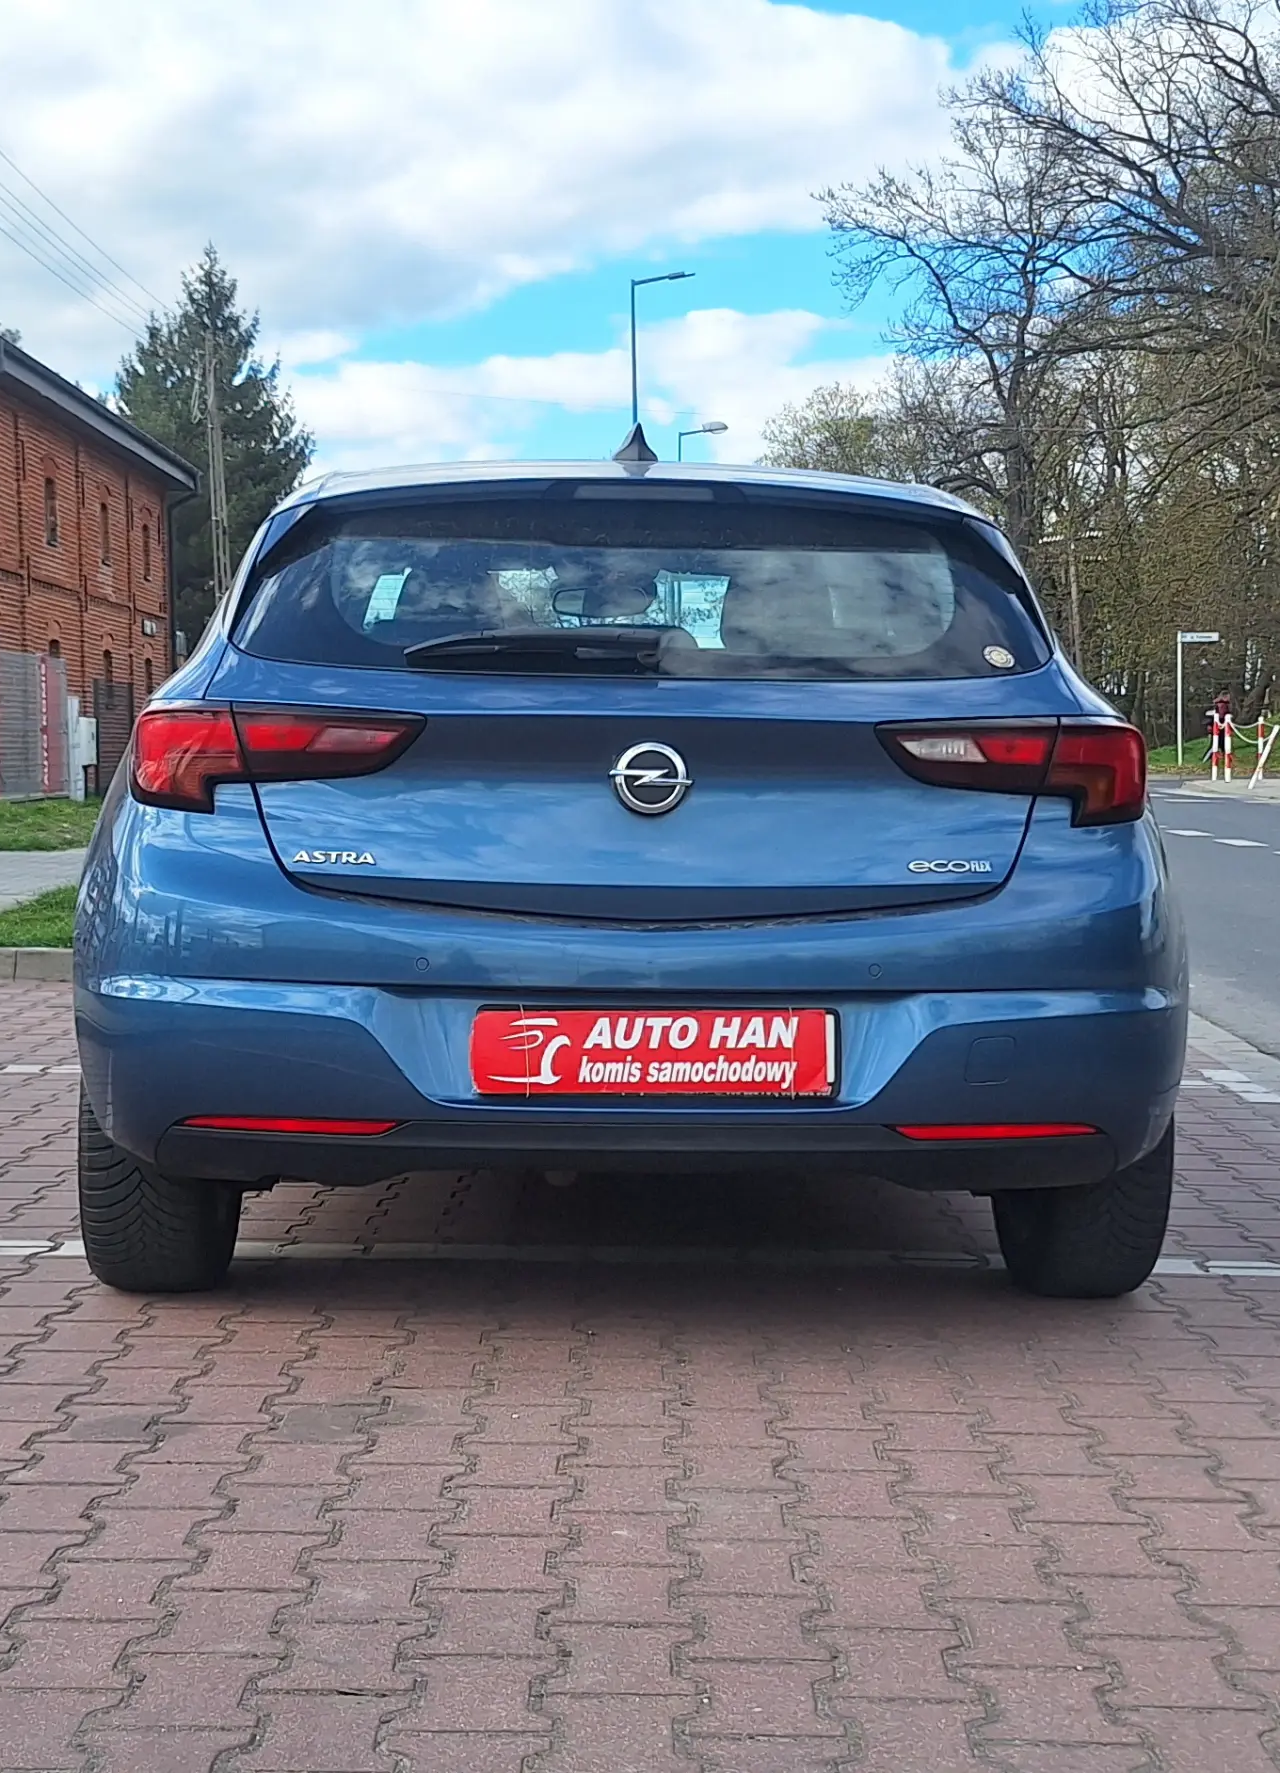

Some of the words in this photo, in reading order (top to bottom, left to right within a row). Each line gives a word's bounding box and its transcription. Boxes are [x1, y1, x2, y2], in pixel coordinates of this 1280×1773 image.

[292, 850, 376, 865] ASTRA
[582, 1016, 699, 1050] AUTO
[709, 1016, 800, 1049] HAN
[577, 1055, 642, 1084] komis
[646, 1054, 798, 1089] samochodowy
